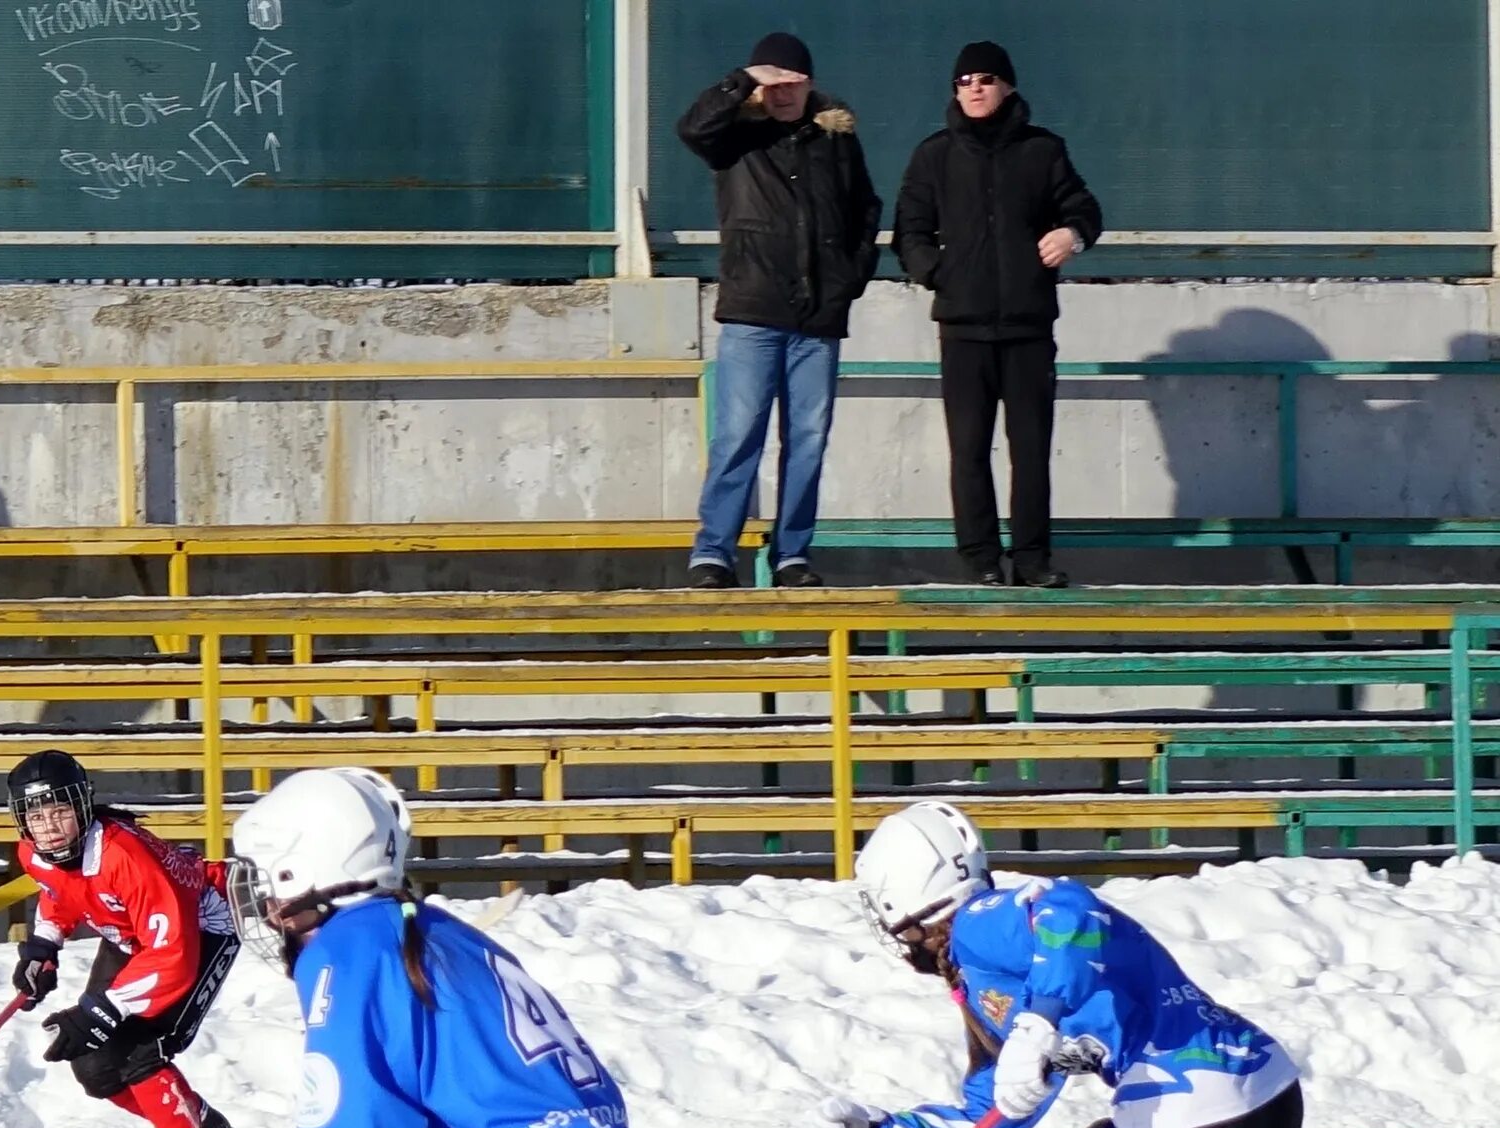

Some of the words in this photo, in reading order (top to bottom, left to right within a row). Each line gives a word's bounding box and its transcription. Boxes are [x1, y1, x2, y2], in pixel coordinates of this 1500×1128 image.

[385, 828, 397, 864] 4
[951, 853, 970, 882] 5
[148, 912, 169, 949] 2
[196, 938, 239, 1011] STEX
[483, 947, 604, 1092] 4
